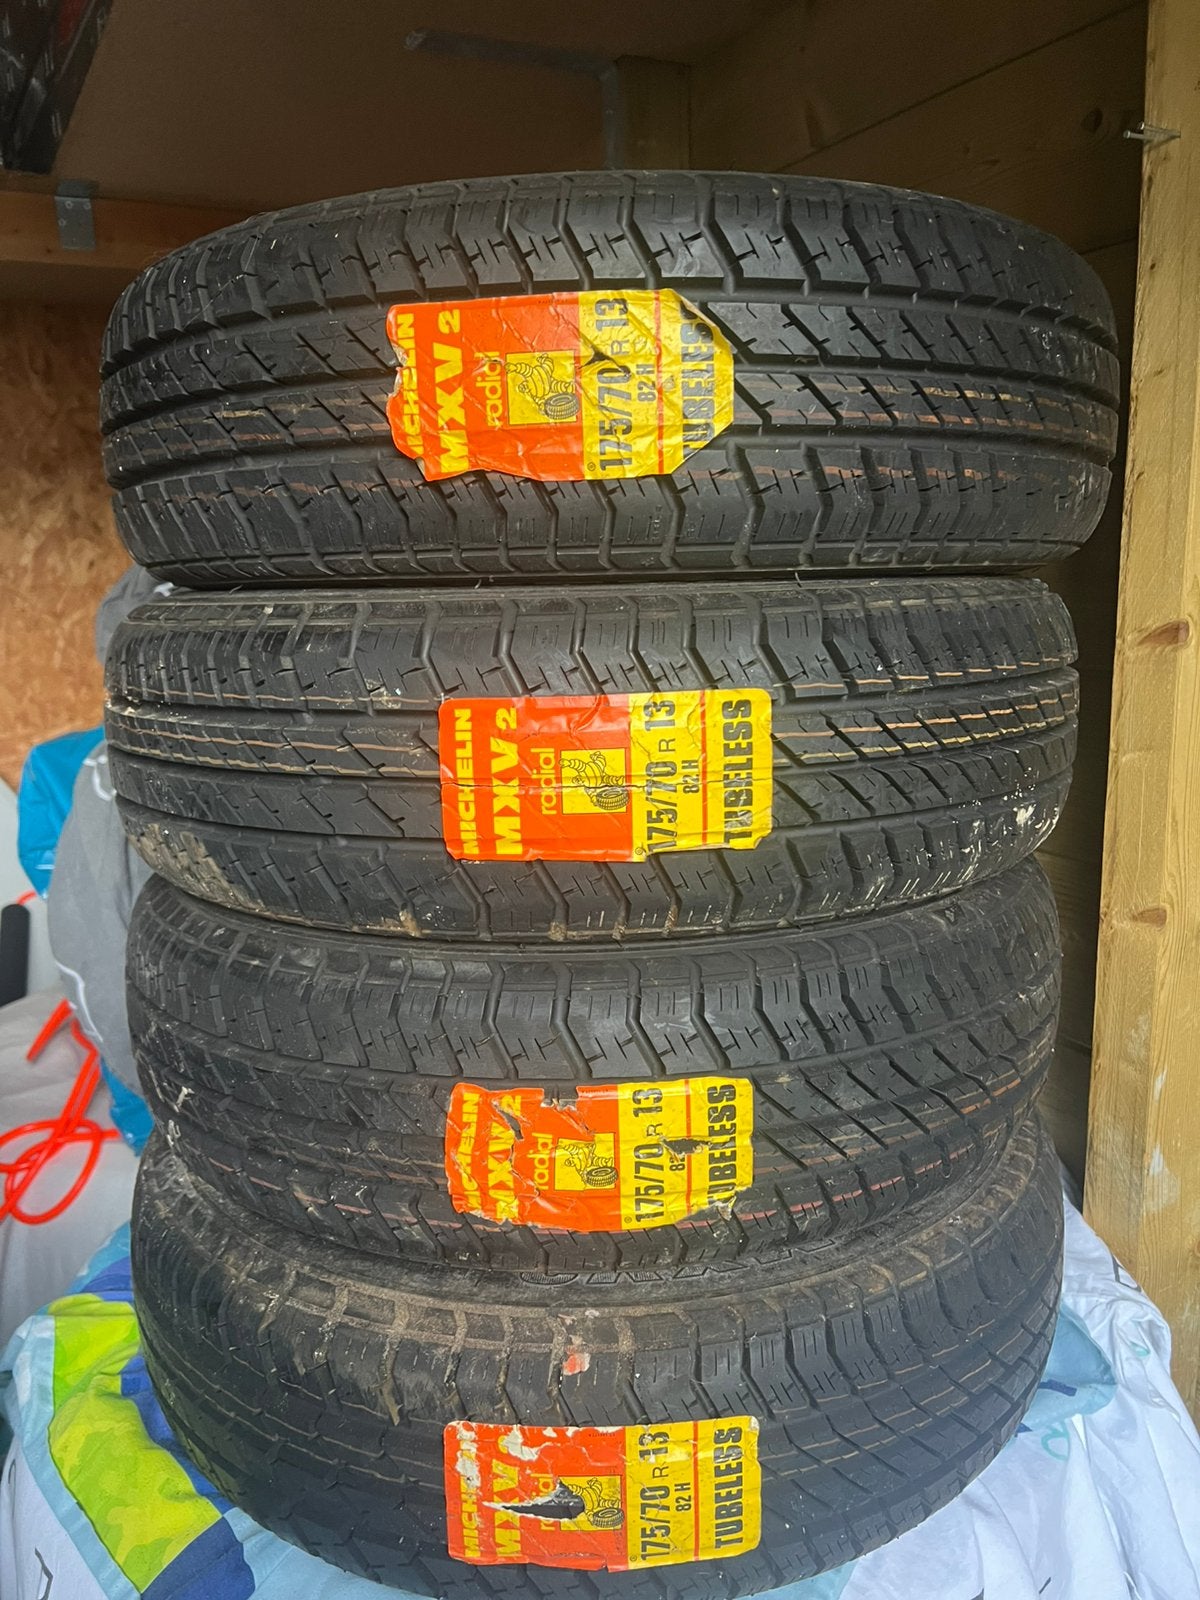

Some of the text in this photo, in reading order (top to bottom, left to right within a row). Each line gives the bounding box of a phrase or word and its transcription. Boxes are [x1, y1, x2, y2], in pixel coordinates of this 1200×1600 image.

[396, 313, 425, 455] ICHELIN
[433, 309, 468, 473] MXV 2
[474, 351, 502, 427] radial
[595, 297, 634, 472] 175/70 R 13
[637, 363, 657, 403] 82 H
[454, 708, 479, 855] MICHELIN
[490, 707, 523, 855] MXV 2
[530, 747, 557, 815] radial
[643, 699, 678, 851] 175/70 R 13
[681, 759, 700, 794] 82 H
[721, 699, 753, 844] TUBELESS
[501, 1094, 521, 1118] 2
[531, 1133, 555, 1191] radial
[632, 1087, 665, 1223] 175/70 R 13
[492, 1458, 522, 1558] MXV
[639, 1431, 671, 1561] 175/70 R 13
[674, 1481, 692, 1512] 82 H
[713, 1426, 743, 1550] TUBELESS
